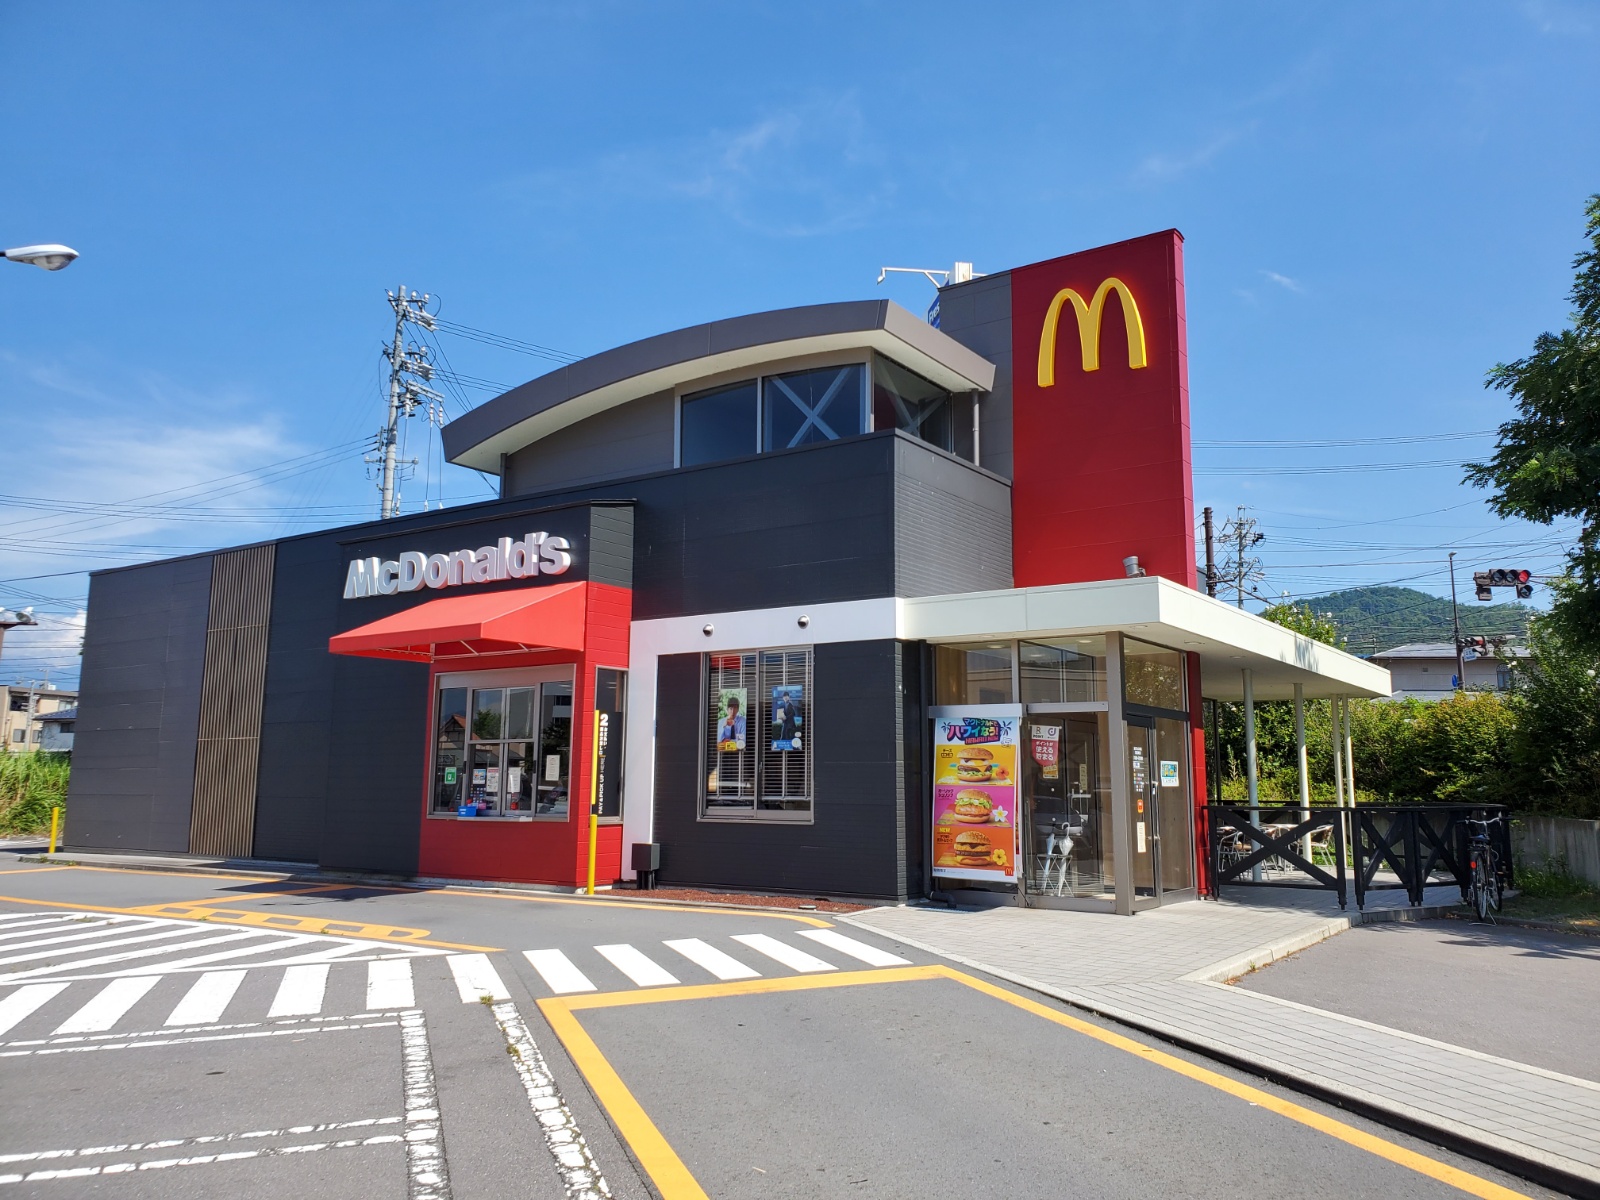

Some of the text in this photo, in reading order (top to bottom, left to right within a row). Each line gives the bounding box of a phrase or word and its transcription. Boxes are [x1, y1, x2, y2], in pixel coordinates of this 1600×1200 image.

[343, 531, 571, 600] McDonald's
[600, 713, 609, 727] 2
[947, 725, 999, 739] ハワイなう!
[1035, 746, 1054, 754] 使える
[1035, 753, 1054, 761] 貯まる
